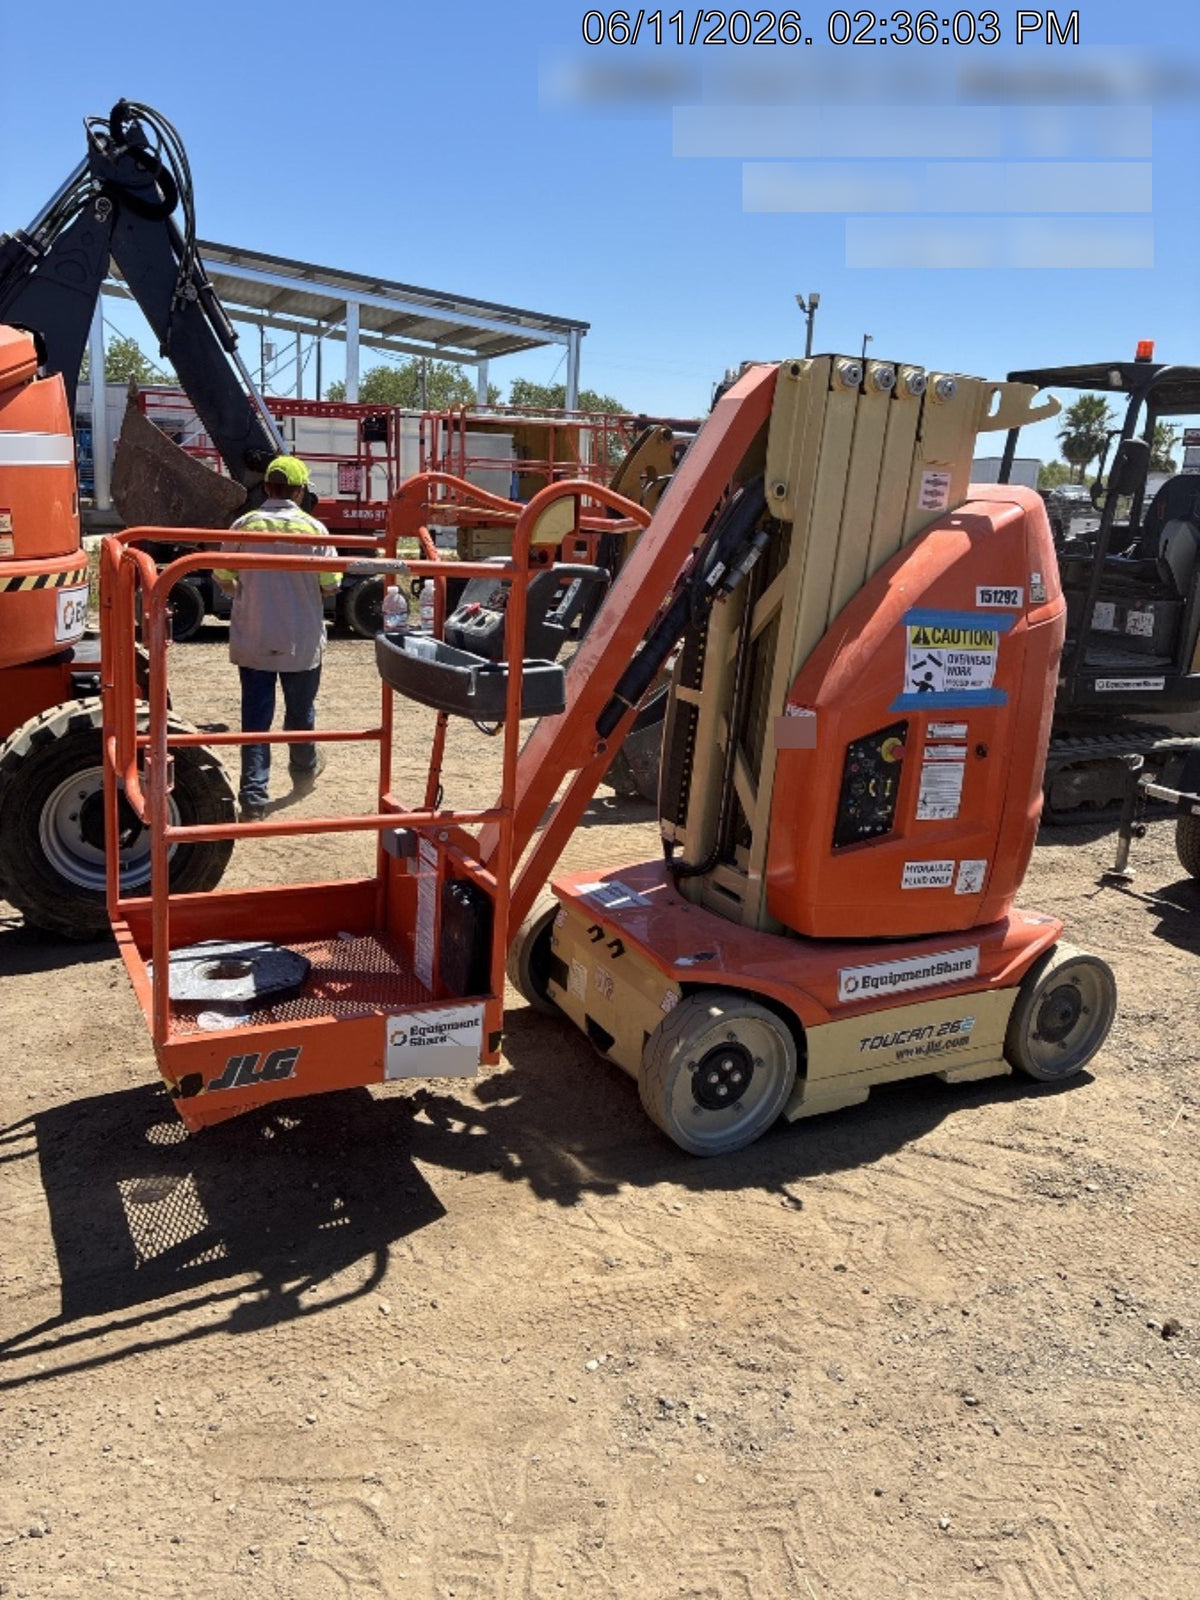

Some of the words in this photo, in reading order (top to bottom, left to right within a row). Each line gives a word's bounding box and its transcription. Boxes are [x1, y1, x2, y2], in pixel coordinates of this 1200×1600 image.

[980, 589, 1018, 605] 151292
[931, 627, 993, 646] CAUTION
[947, 653, 991, 666] OVERHEAD
[947, 666, 972, 677] WORK
[906, 863, 953, 874] HYDRAULIC
[904, 876, 928, 886] FLUID
[929, 875, 951, 885] ONLY
[861, 959, 972, 990] EquipmentShare
[409, 1018, 480, 1037] Equipment
[409, 1034, 448, 1047] Share
[860, 1025, 936, 1051] TOUCAN
[896, 1035, 970, 1060] www.jlg.com
[207, 1045, 303, 1092] JLG
